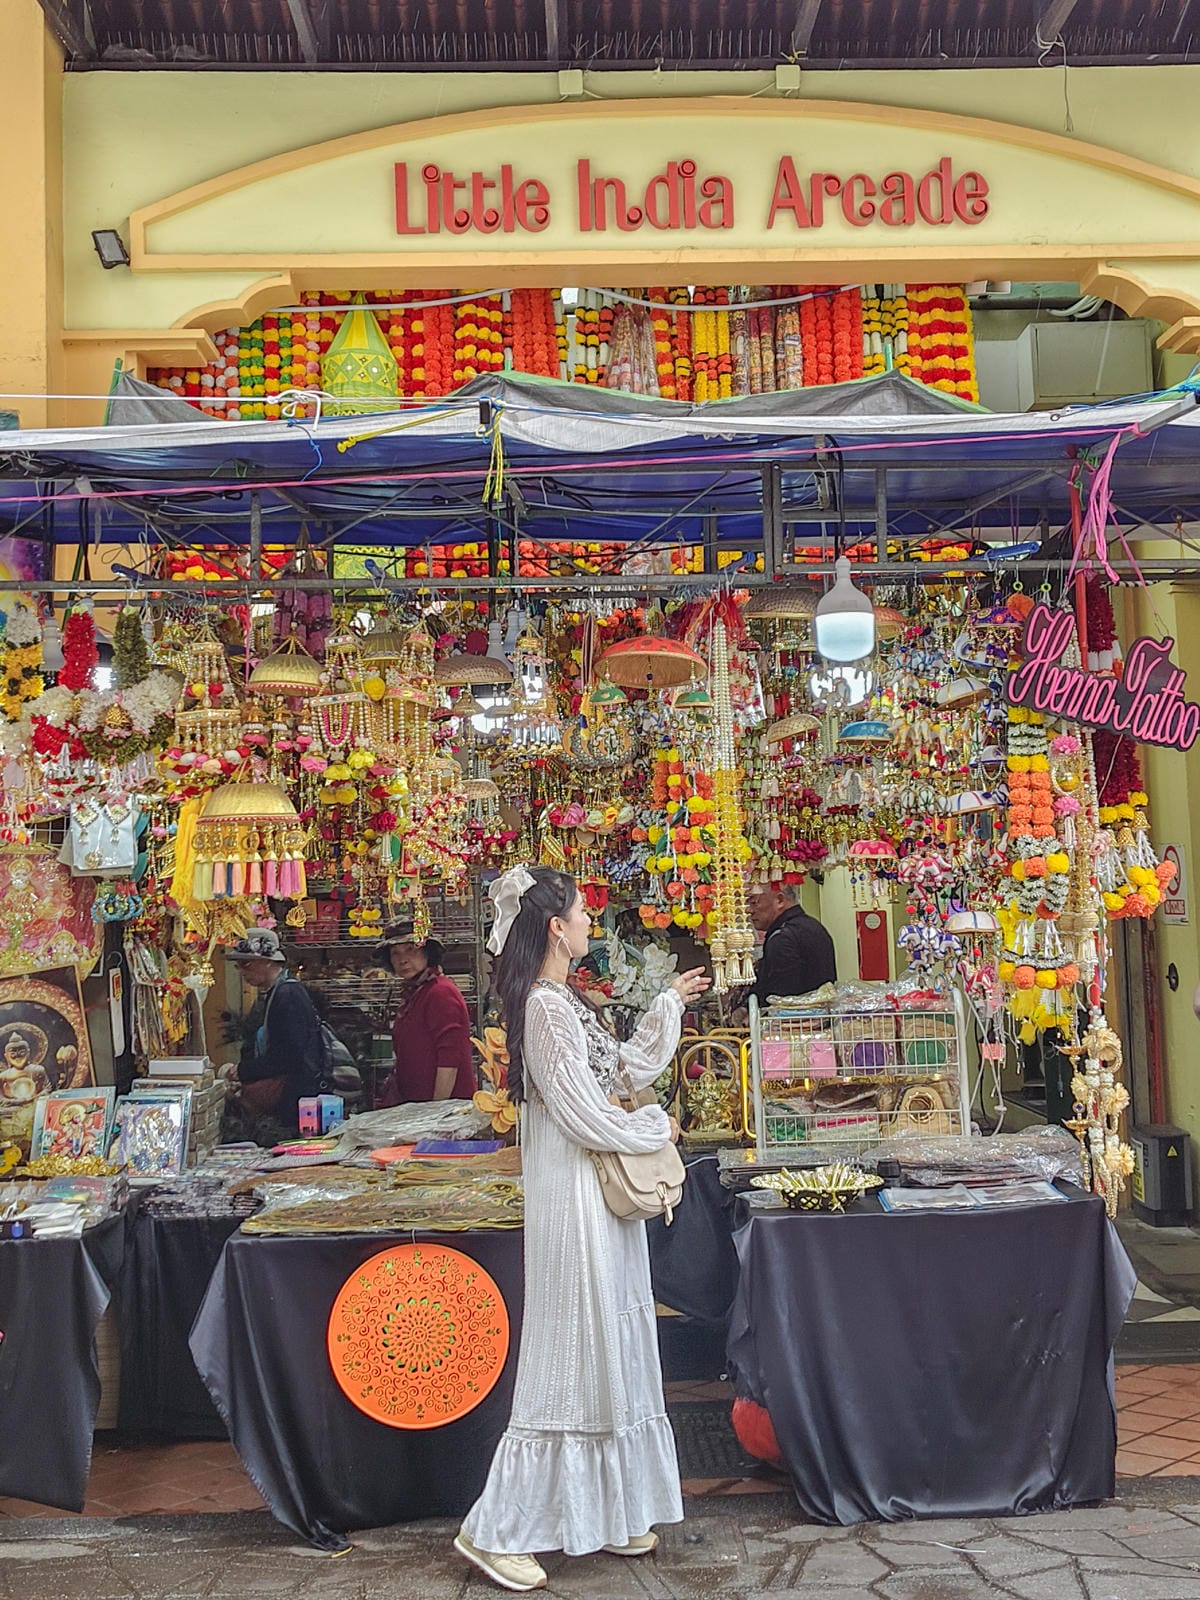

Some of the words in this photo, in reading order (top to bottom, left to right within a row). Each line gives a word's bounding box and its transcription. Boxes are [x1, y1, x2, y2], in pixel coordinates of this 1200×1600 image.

[394, 162, 551, 235] Little
[577, 159, 735, 232] India
[767, 155, 989, 229] Arcade
[1008, 605, 1118, 724] Henna
[1113, 639, 1200, 748] Tattoo
